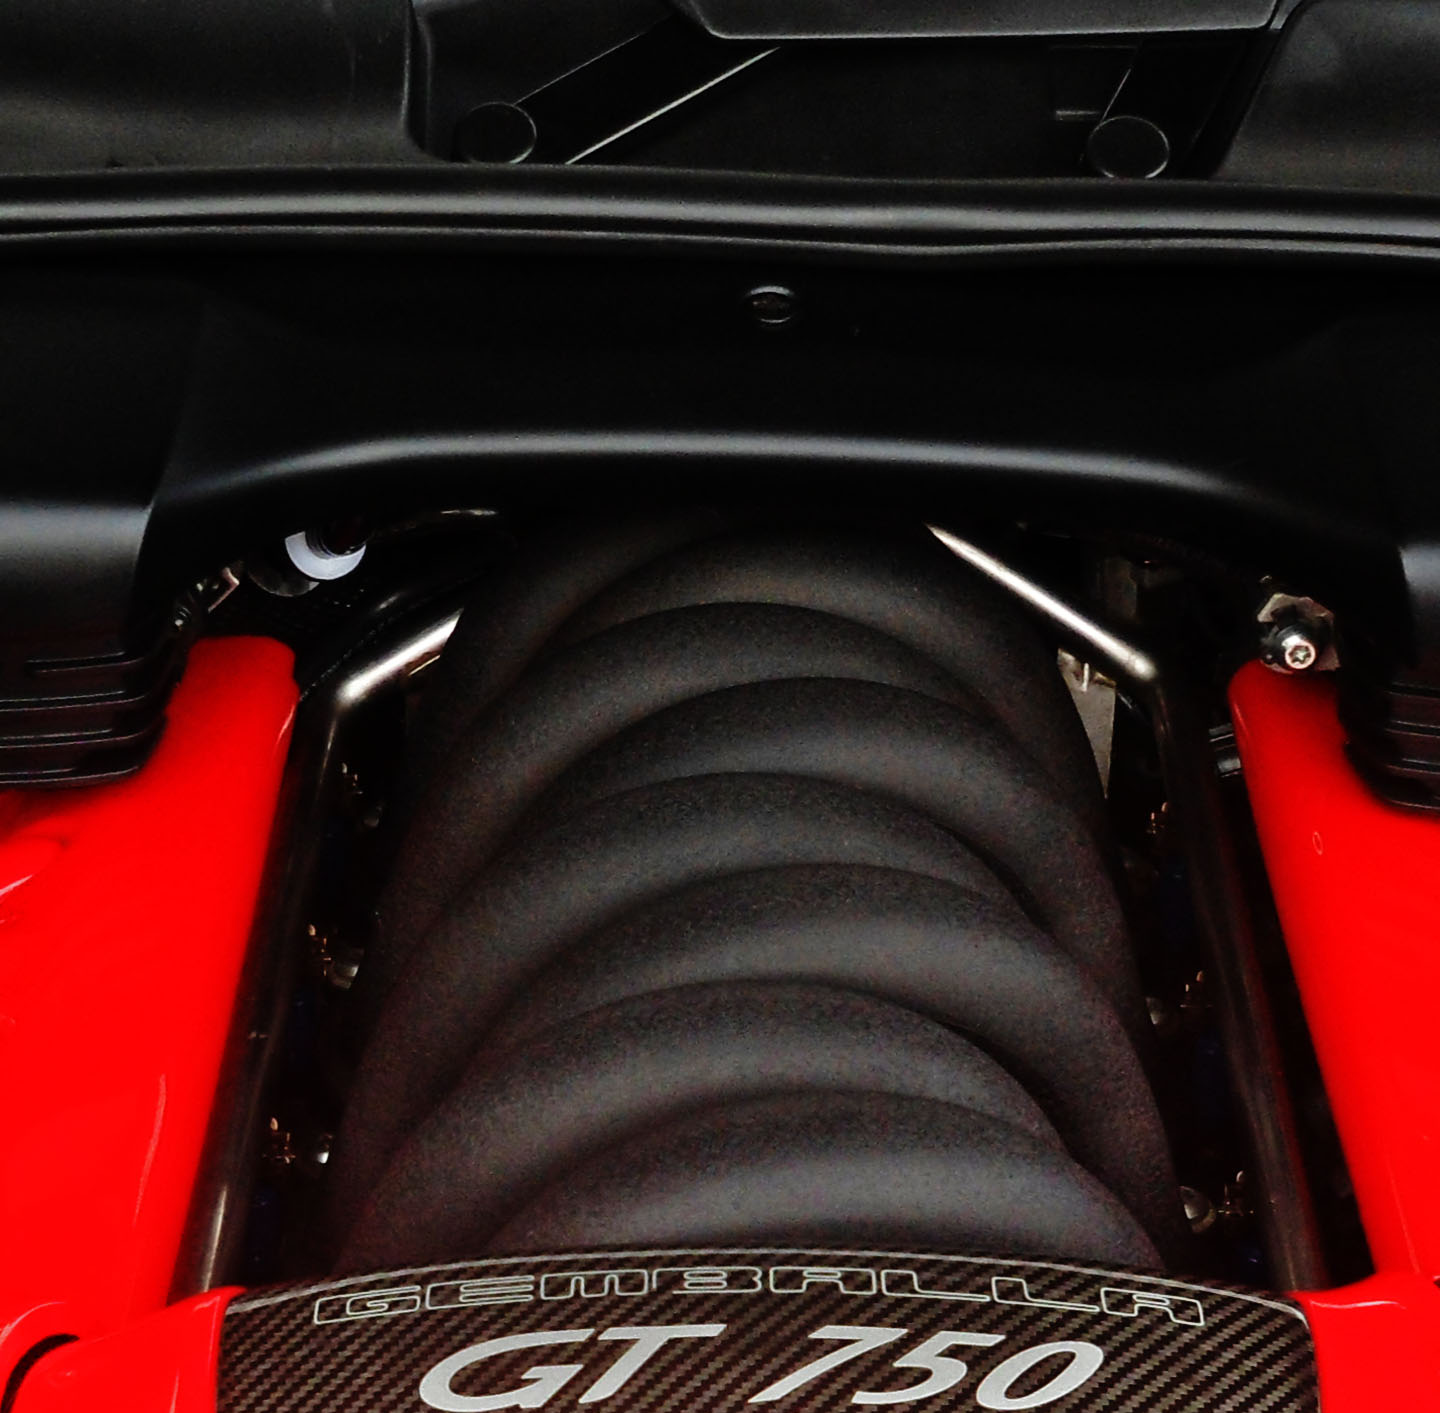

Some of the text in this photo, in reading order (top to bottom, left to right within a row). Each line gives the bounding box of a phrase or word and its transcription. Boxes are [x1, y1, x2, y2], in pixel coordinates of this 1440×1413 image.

[313, 1265, 1205, 1327] GEMBALLA
[418, 1323, 1105, 1413] GT 750
